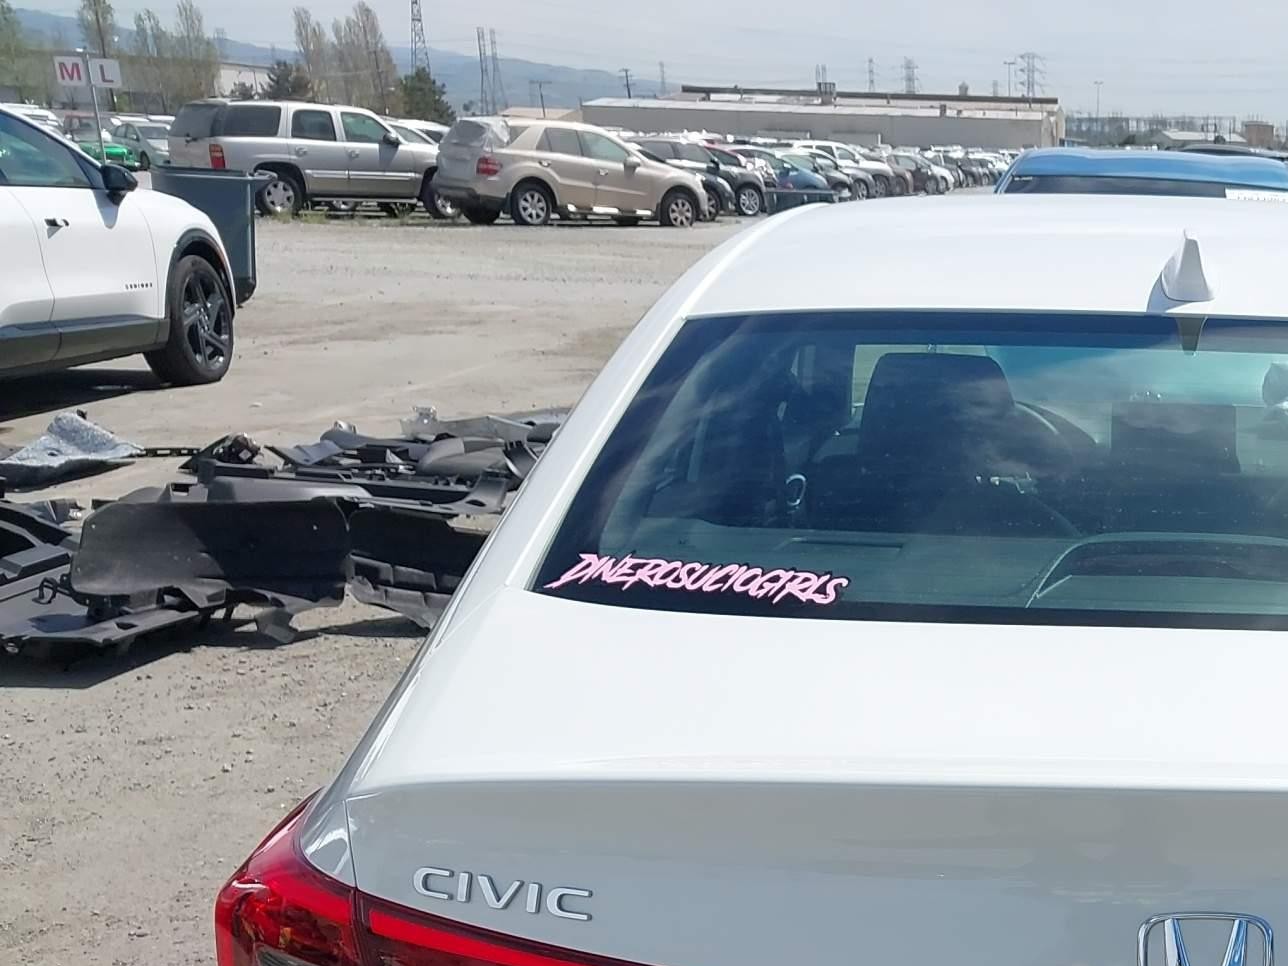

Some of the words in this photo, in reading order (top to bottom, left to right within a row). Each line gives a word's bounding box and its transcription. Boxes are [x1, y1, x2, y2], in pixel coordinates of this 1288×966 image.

[58, 62, 82, 81] M
[99, 63, 114, 83] L
[412, 866, 593, 921] CIVIC
